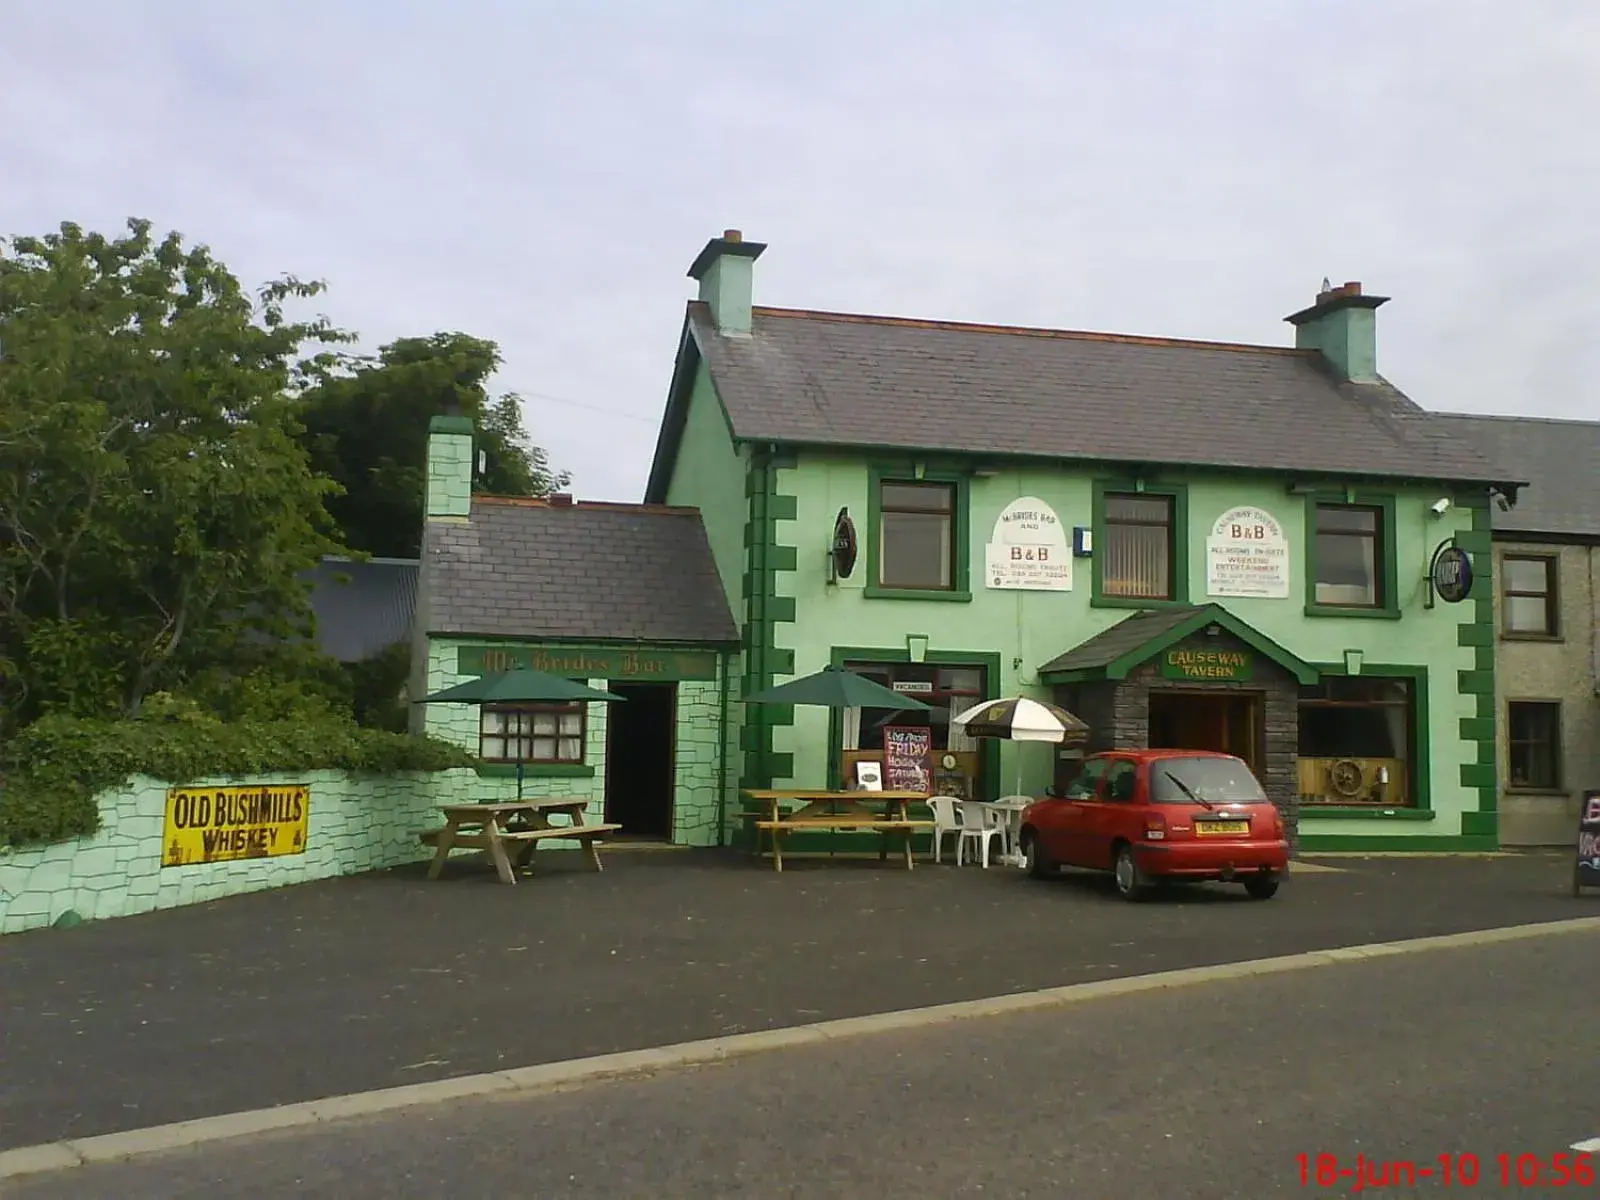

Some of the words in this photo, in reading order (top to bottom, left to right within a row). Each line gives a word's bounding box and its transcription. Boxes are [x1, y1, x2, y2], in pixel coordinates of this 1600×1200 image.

[1168, 651, 1245, 666] CAUSEWAY
[1183, 665, 1234, 677] TAVERN
[888, 741, 929, 757] FRIDAY
[174, 793, 211, 829] OLD
[214, 791, 303, 827] BUSHMILLS
[202, 828, 278, 853] WHISKEY
